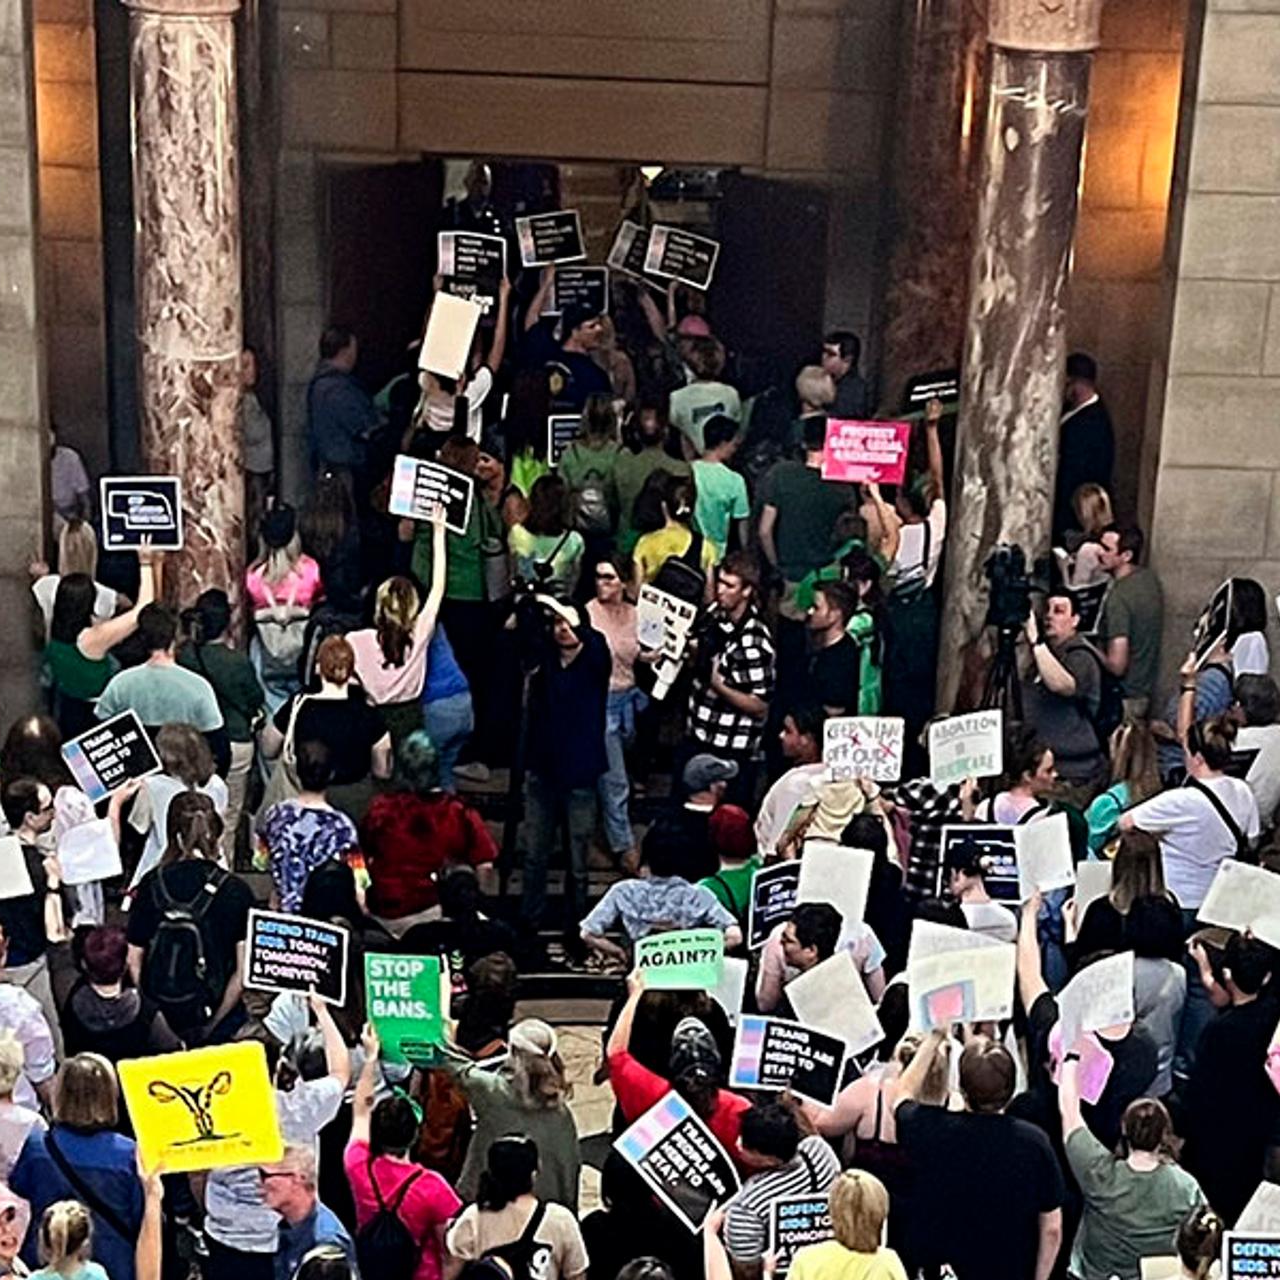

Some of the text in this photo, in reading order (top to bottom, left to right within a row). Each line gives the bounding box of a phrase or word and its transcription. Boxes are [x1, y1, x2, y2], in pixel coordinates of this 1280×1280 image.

[370, 959, 425, 978] STOP
[639, 949, 717, 969] AGAIN??
[372, 980, 412, 999] THE
[373, 1000, 434, 1019] BANS.
[1232, 1260, 1268, 1274] KIDS:
